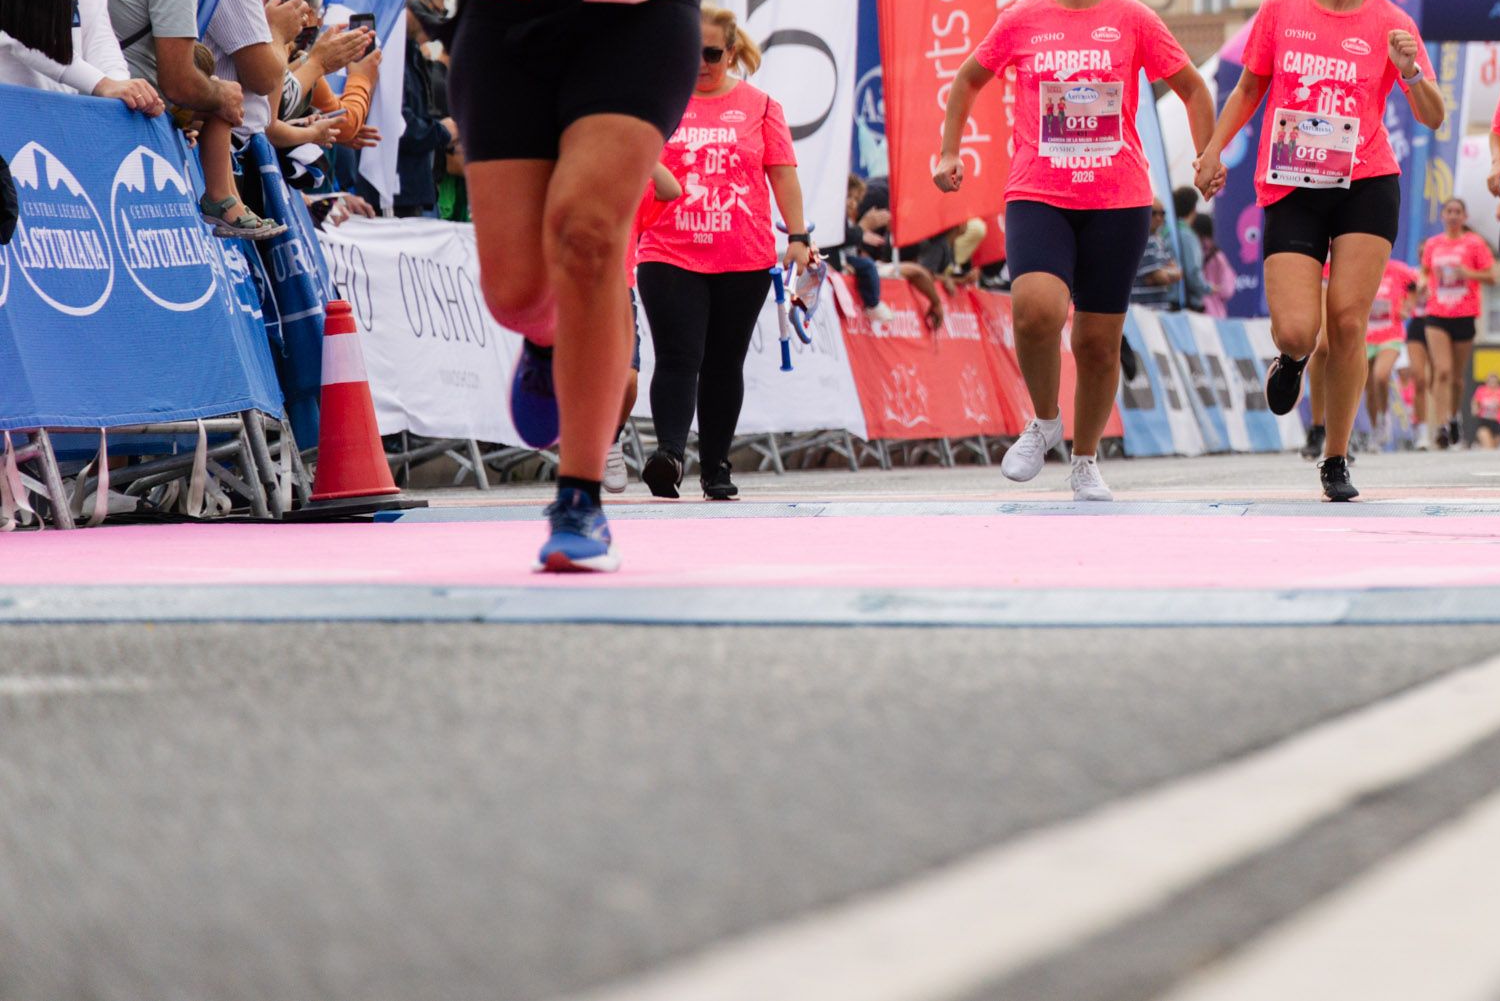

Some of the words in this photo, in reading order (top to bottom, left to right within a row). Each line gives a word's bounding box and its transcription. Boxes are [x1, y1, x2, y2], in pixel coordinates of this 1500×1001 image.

[1031, 32, 1064, 45] OYSHO
[1284, 28, 1317, 40] OYSHO
[1034, 49, 1112, 73] CARRERA
[1283, 50, 1357, 84] CARRERA
[1066, 116, 1098, 129] 016
[705, 147, 727, 175] DE
[1296, 146, 1327, 161] 016
[1072, 171, 1095, 183] 2026
[675, 211, 732, 232] MUJER
[18, 215, 109, 270] ASTURIANA
[399, 251, 486, 348] OYSHO
